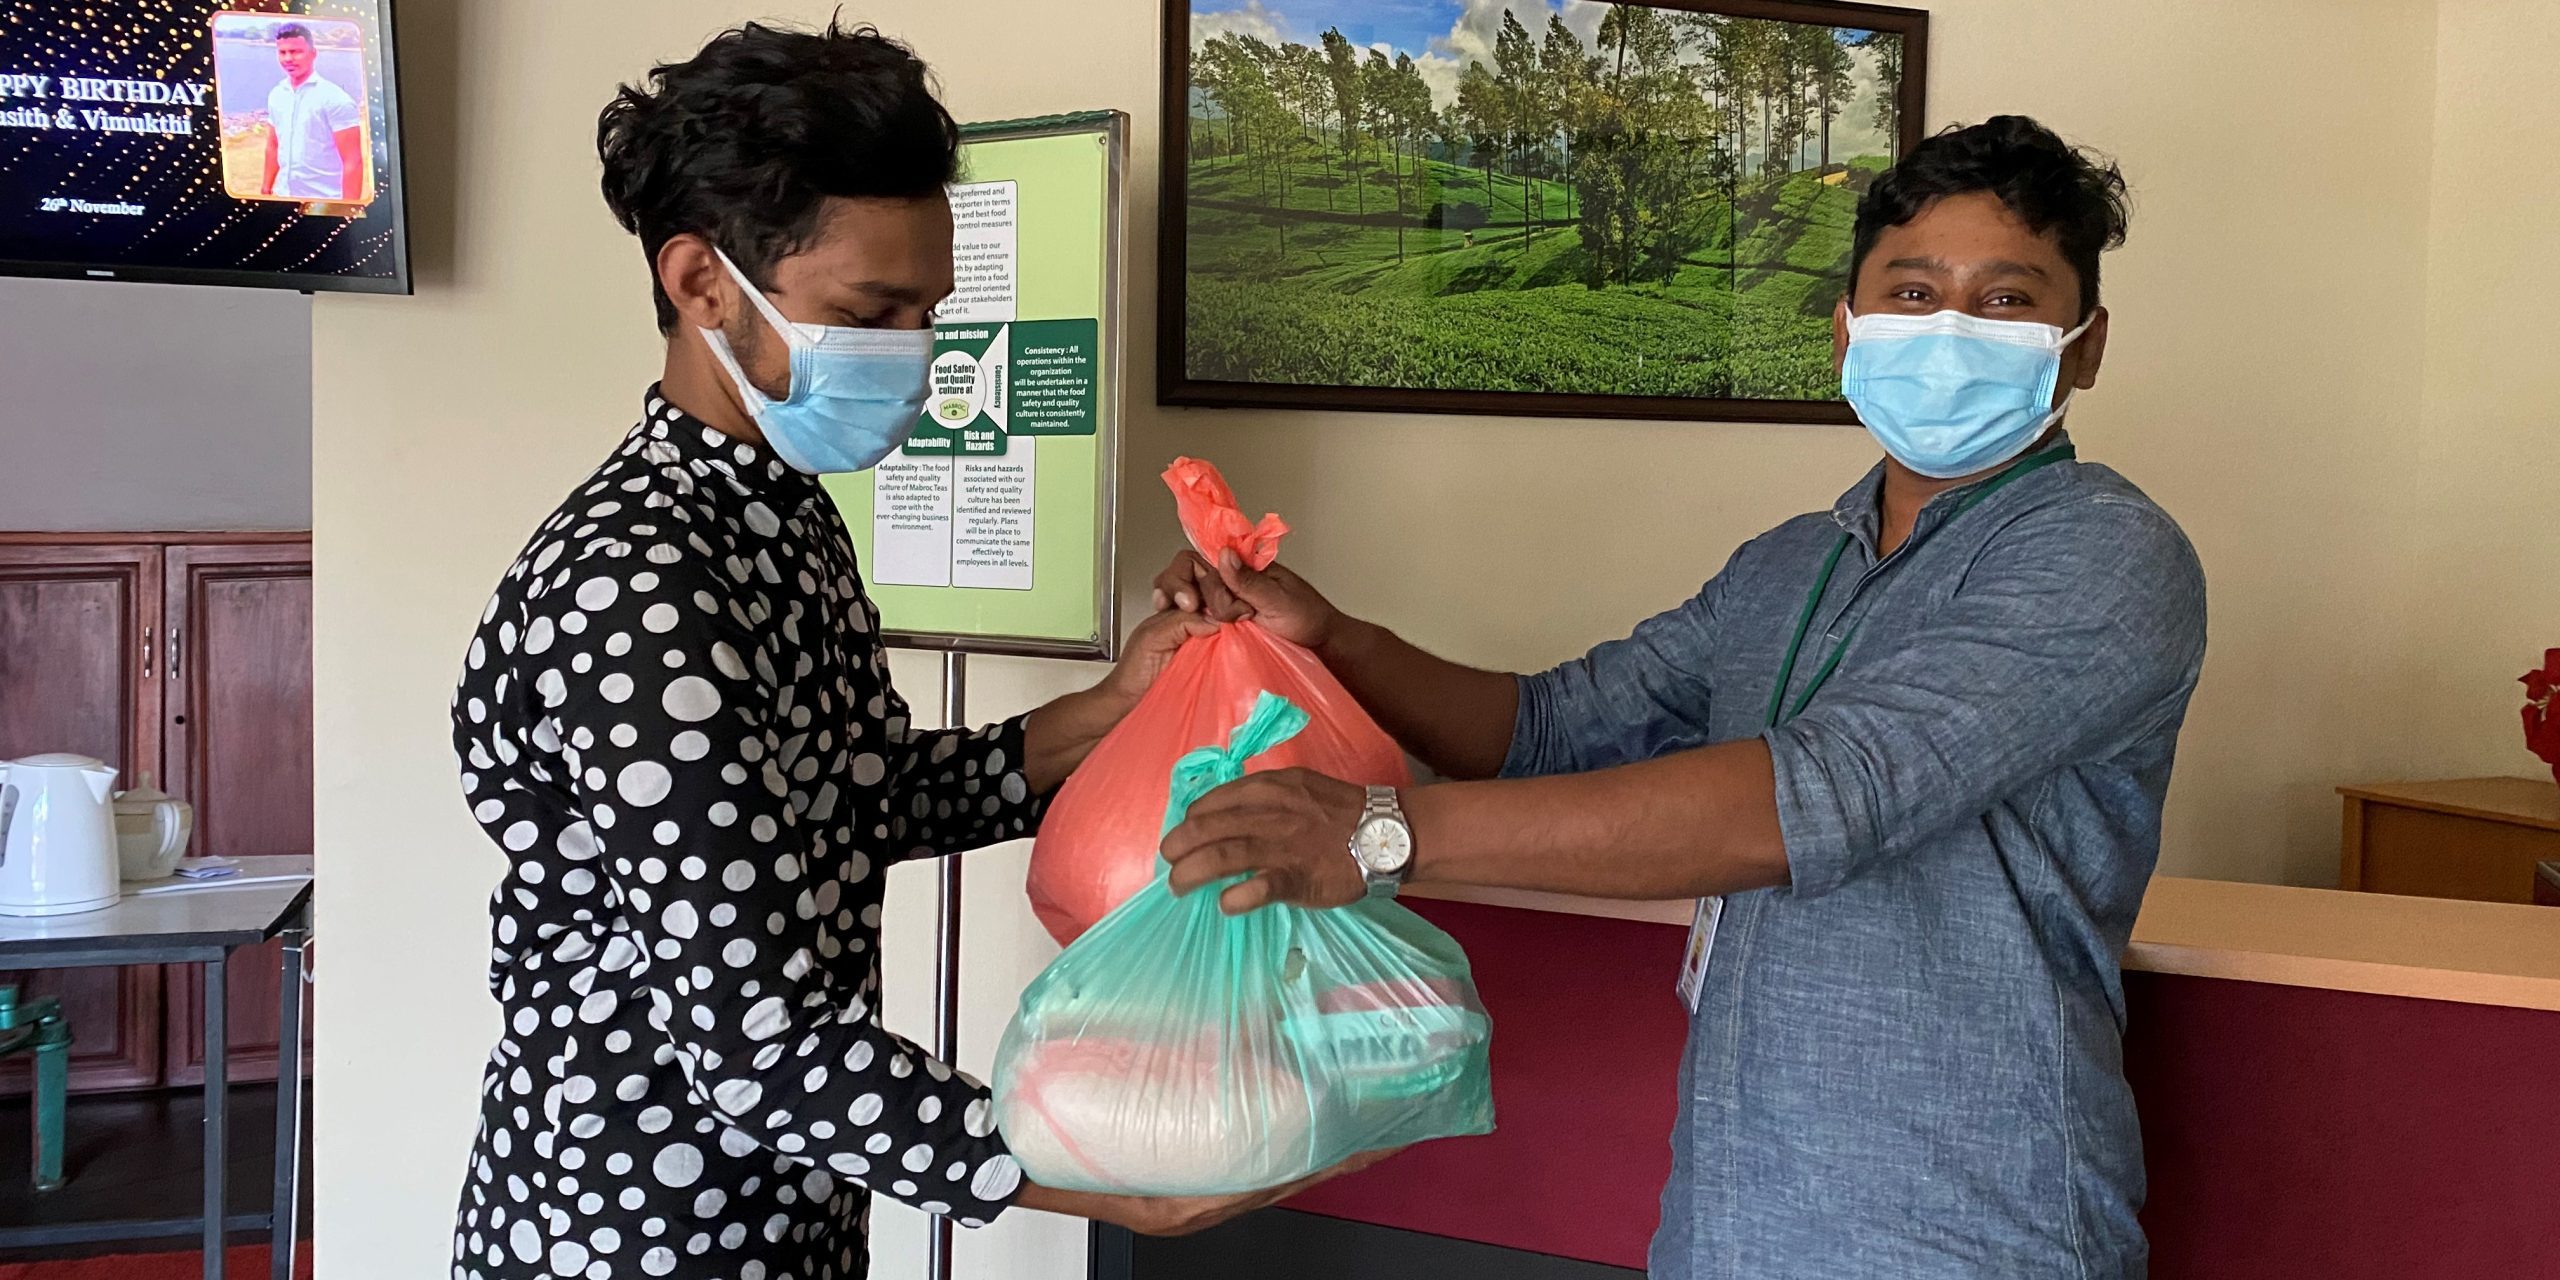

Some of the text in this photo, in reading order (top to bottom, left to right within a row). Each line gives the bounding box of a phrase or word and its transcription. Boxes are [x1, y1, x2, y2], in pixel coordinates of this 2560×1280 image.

[59, 77, 207, 106] BIRTHDAY
[55, 108, 77, 129] &
[80, 109, 192, 134] Vimukthi
[961, 189, 991, 198] preferred
[69, 199, 145, 215] November
[955, 201, 983, 209] exporter
[976, 210, 989, 218] best
[957, 221, 980, 229] control
[965, 264, 972, 272] by
[959, 285, 981, 293] control
[971, 295, 1012, 303] stakeholders
[945, 330, 958, 340] and
[960, 329, 988, 339] mission
[1025, 347, 1065, 355] Consistency
[1017, 358, 1051, 367] operations
[935, 364, 975, 374] Food Safety
[1030, 368, 1071, 377] organization
[936, 375, 975, 384] and Quality
[939, 386, 973, 394] culture at
[1022, 399, 1041, 408] safety
[1056, 399, 1079, 408] quality
[1046, 409, 1085, 418] consistently
[964, 431, 994, 440] Risk and
[908, 438, 950, 448] Adaptability
[966, 441, 994, 450] Hazards
[879, 464, 918, 472] Adaptability
[886, 474, 904, 482] safety
[919, 474, 941, 482] quality
[998, 475, 1012, 483] with
[966, 486, 984, 494] safety
[1000, 486, 1022, 494] quality
[906, 494, 931, 502] adapted
[1002, 507, 1031, 515] reviewed
[995, 528, 1012, 536] place
[972, 548, 1005, 557] effectively
[957, 559, 990, 567] employees
